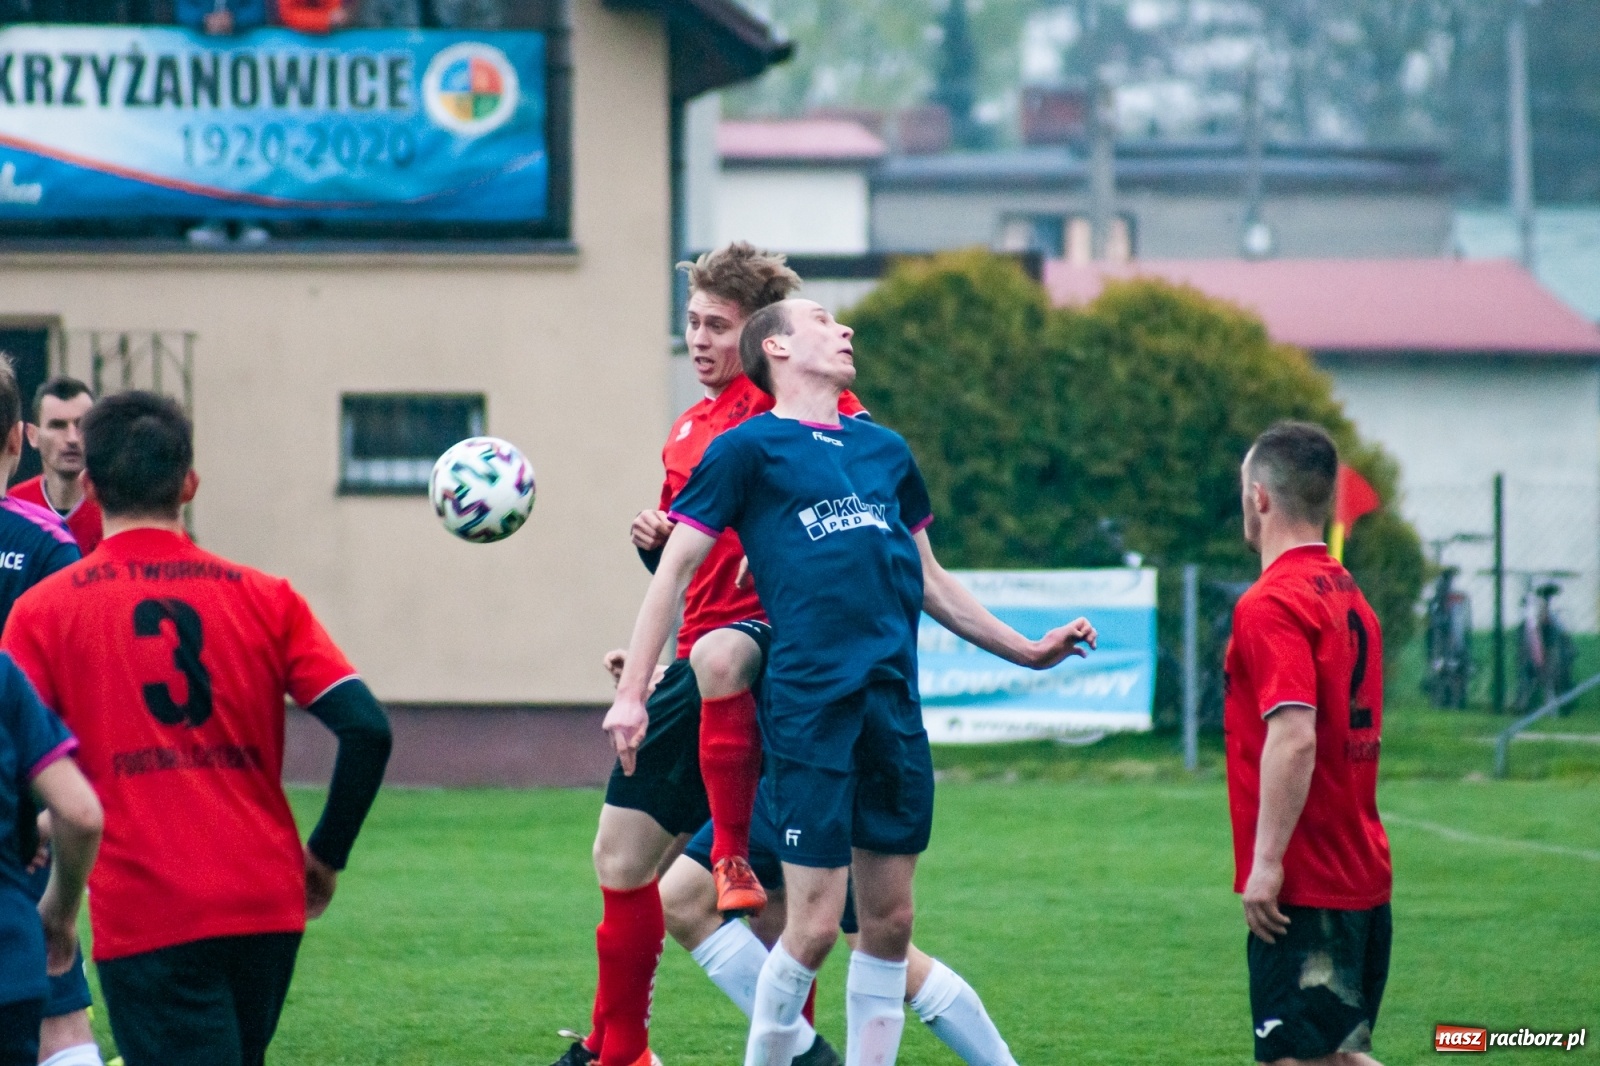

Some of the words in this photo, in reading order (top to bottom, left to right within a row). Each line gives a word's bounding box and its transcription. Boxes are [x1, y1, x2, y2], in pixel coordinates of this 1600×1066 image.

[181, 123, 416, 168] 1920-2020
[133, 597, 213, 728] 3
[1347, 608, 1373, 729] 2
